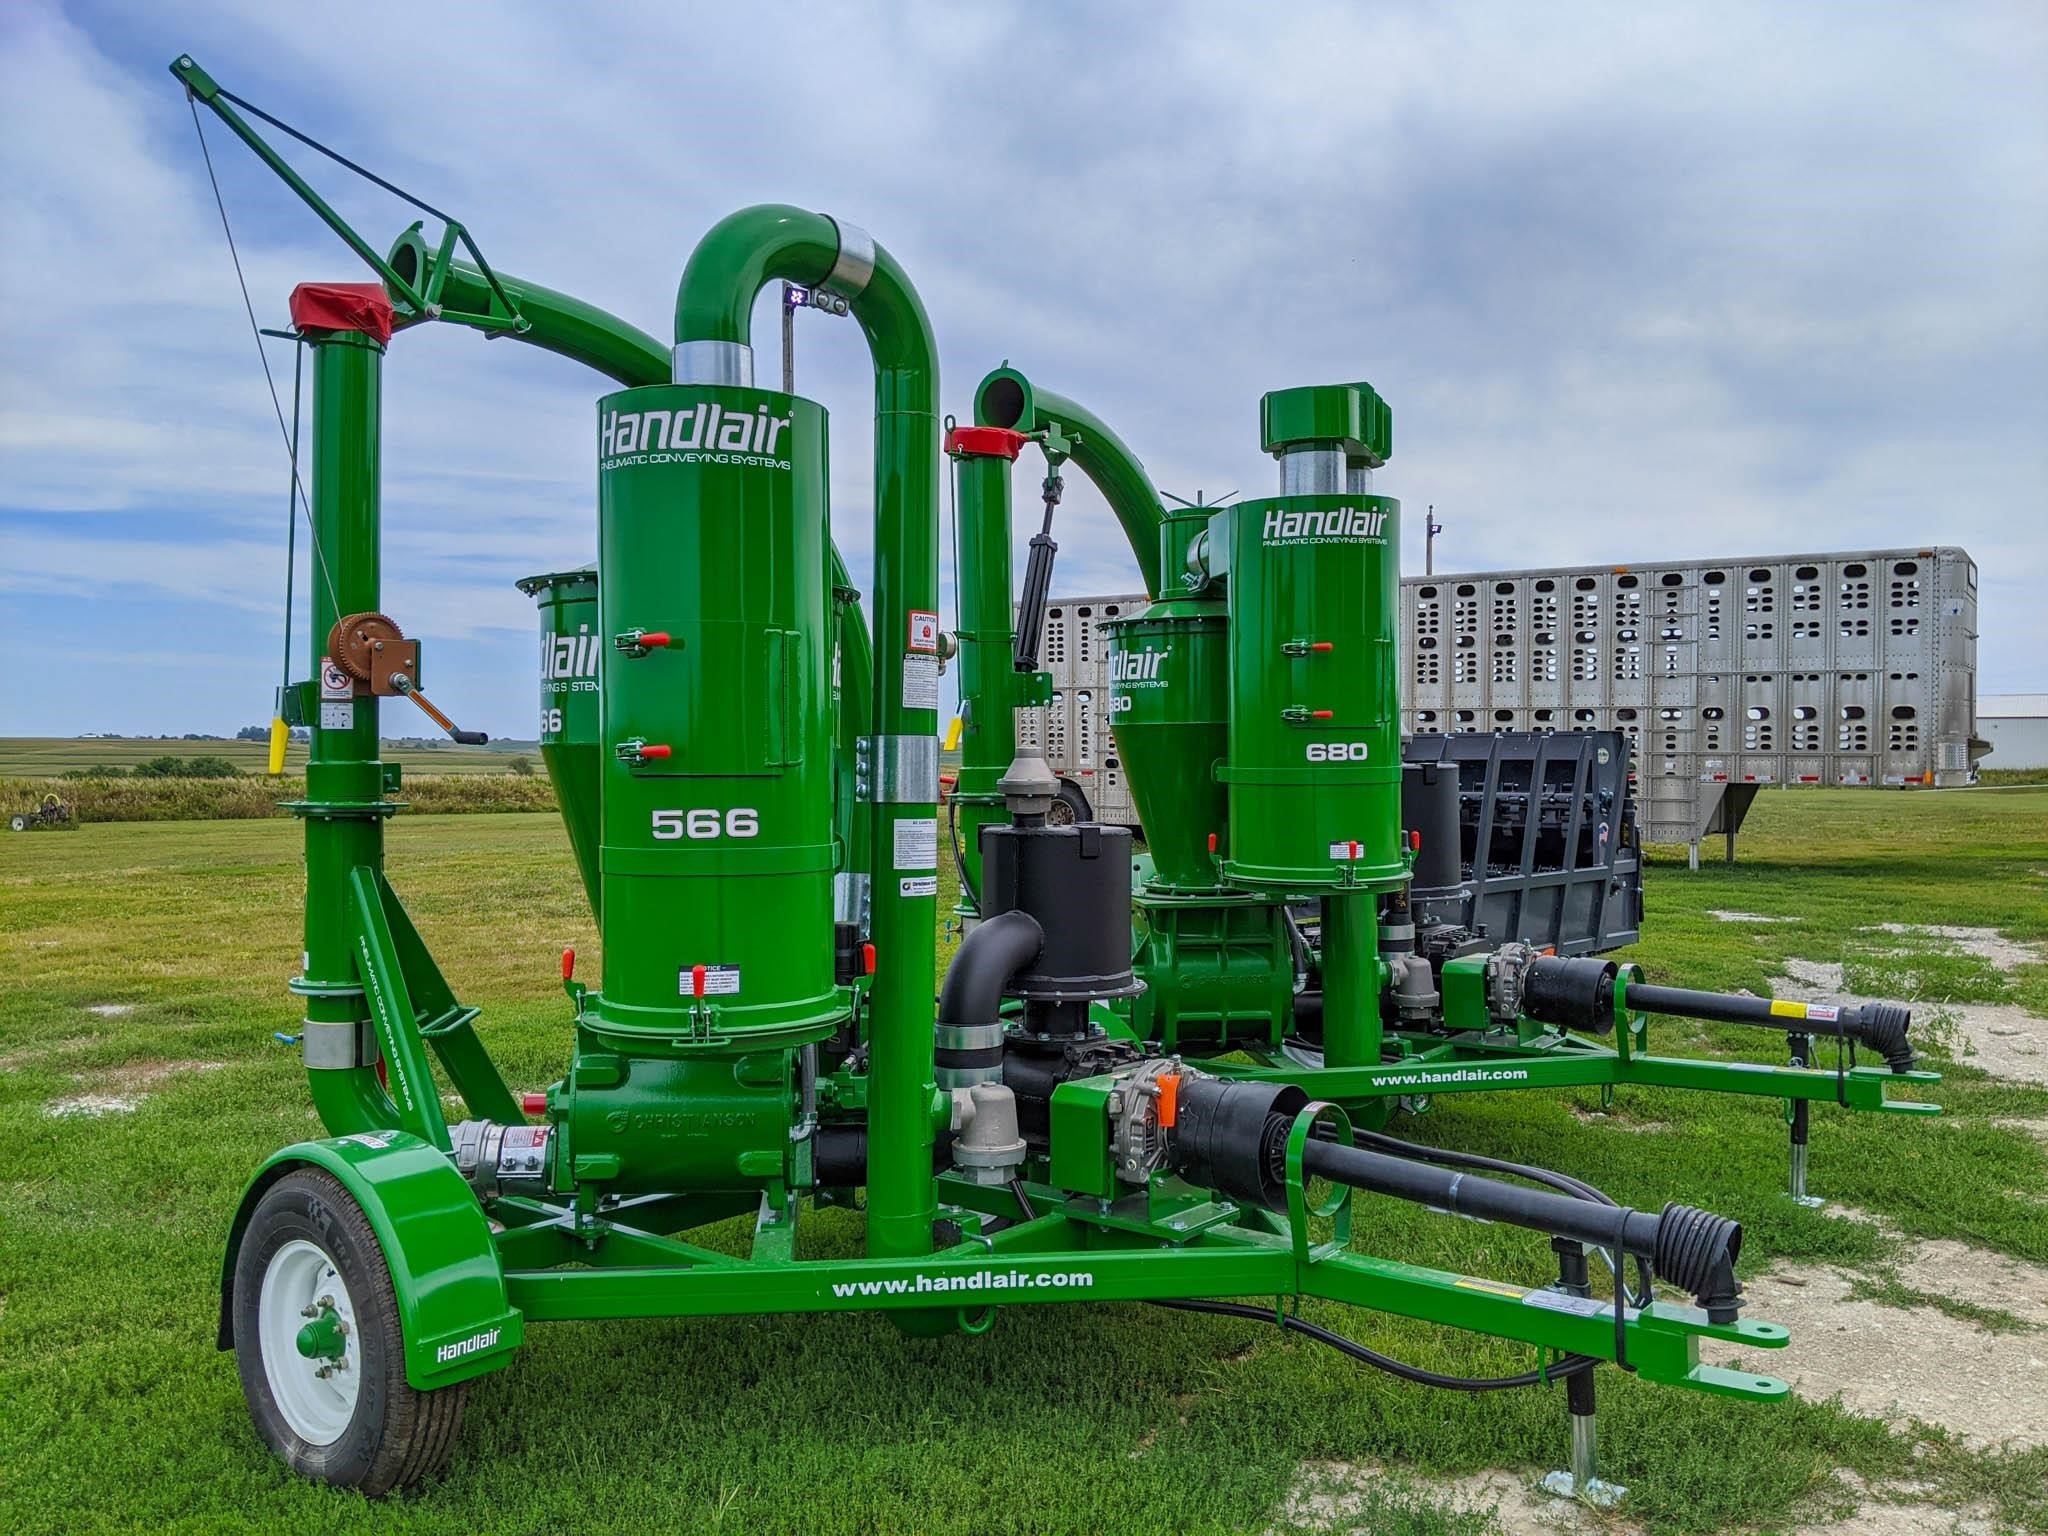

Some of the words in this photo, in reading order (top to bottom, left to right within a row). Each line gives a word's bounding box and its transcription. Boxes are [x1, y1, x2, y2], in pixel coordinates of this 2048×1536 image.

[600, 454, 648, 473] PNEUMATIC
[649, 453, 729, 465] CONVEYING
[731, 454, 791, 471] SYSTEMS
[1262, 505, 1388, 539] Handlair
[1262, 538, 1309, 547] PNEUMATIC
[1309, 537, 1358, 545] CONVEYING
[1358, 538, 1388, 546] SYSTEMS
[1305, 742, 1368, 762] 680
[651, 807, 760, 840] 566
[1371, 1069, 1528, 1087] www.handlair.com
[831, 1270, 1094, 1298] www.handlair.com
[437, 1328, 502, 1364] Handlair
